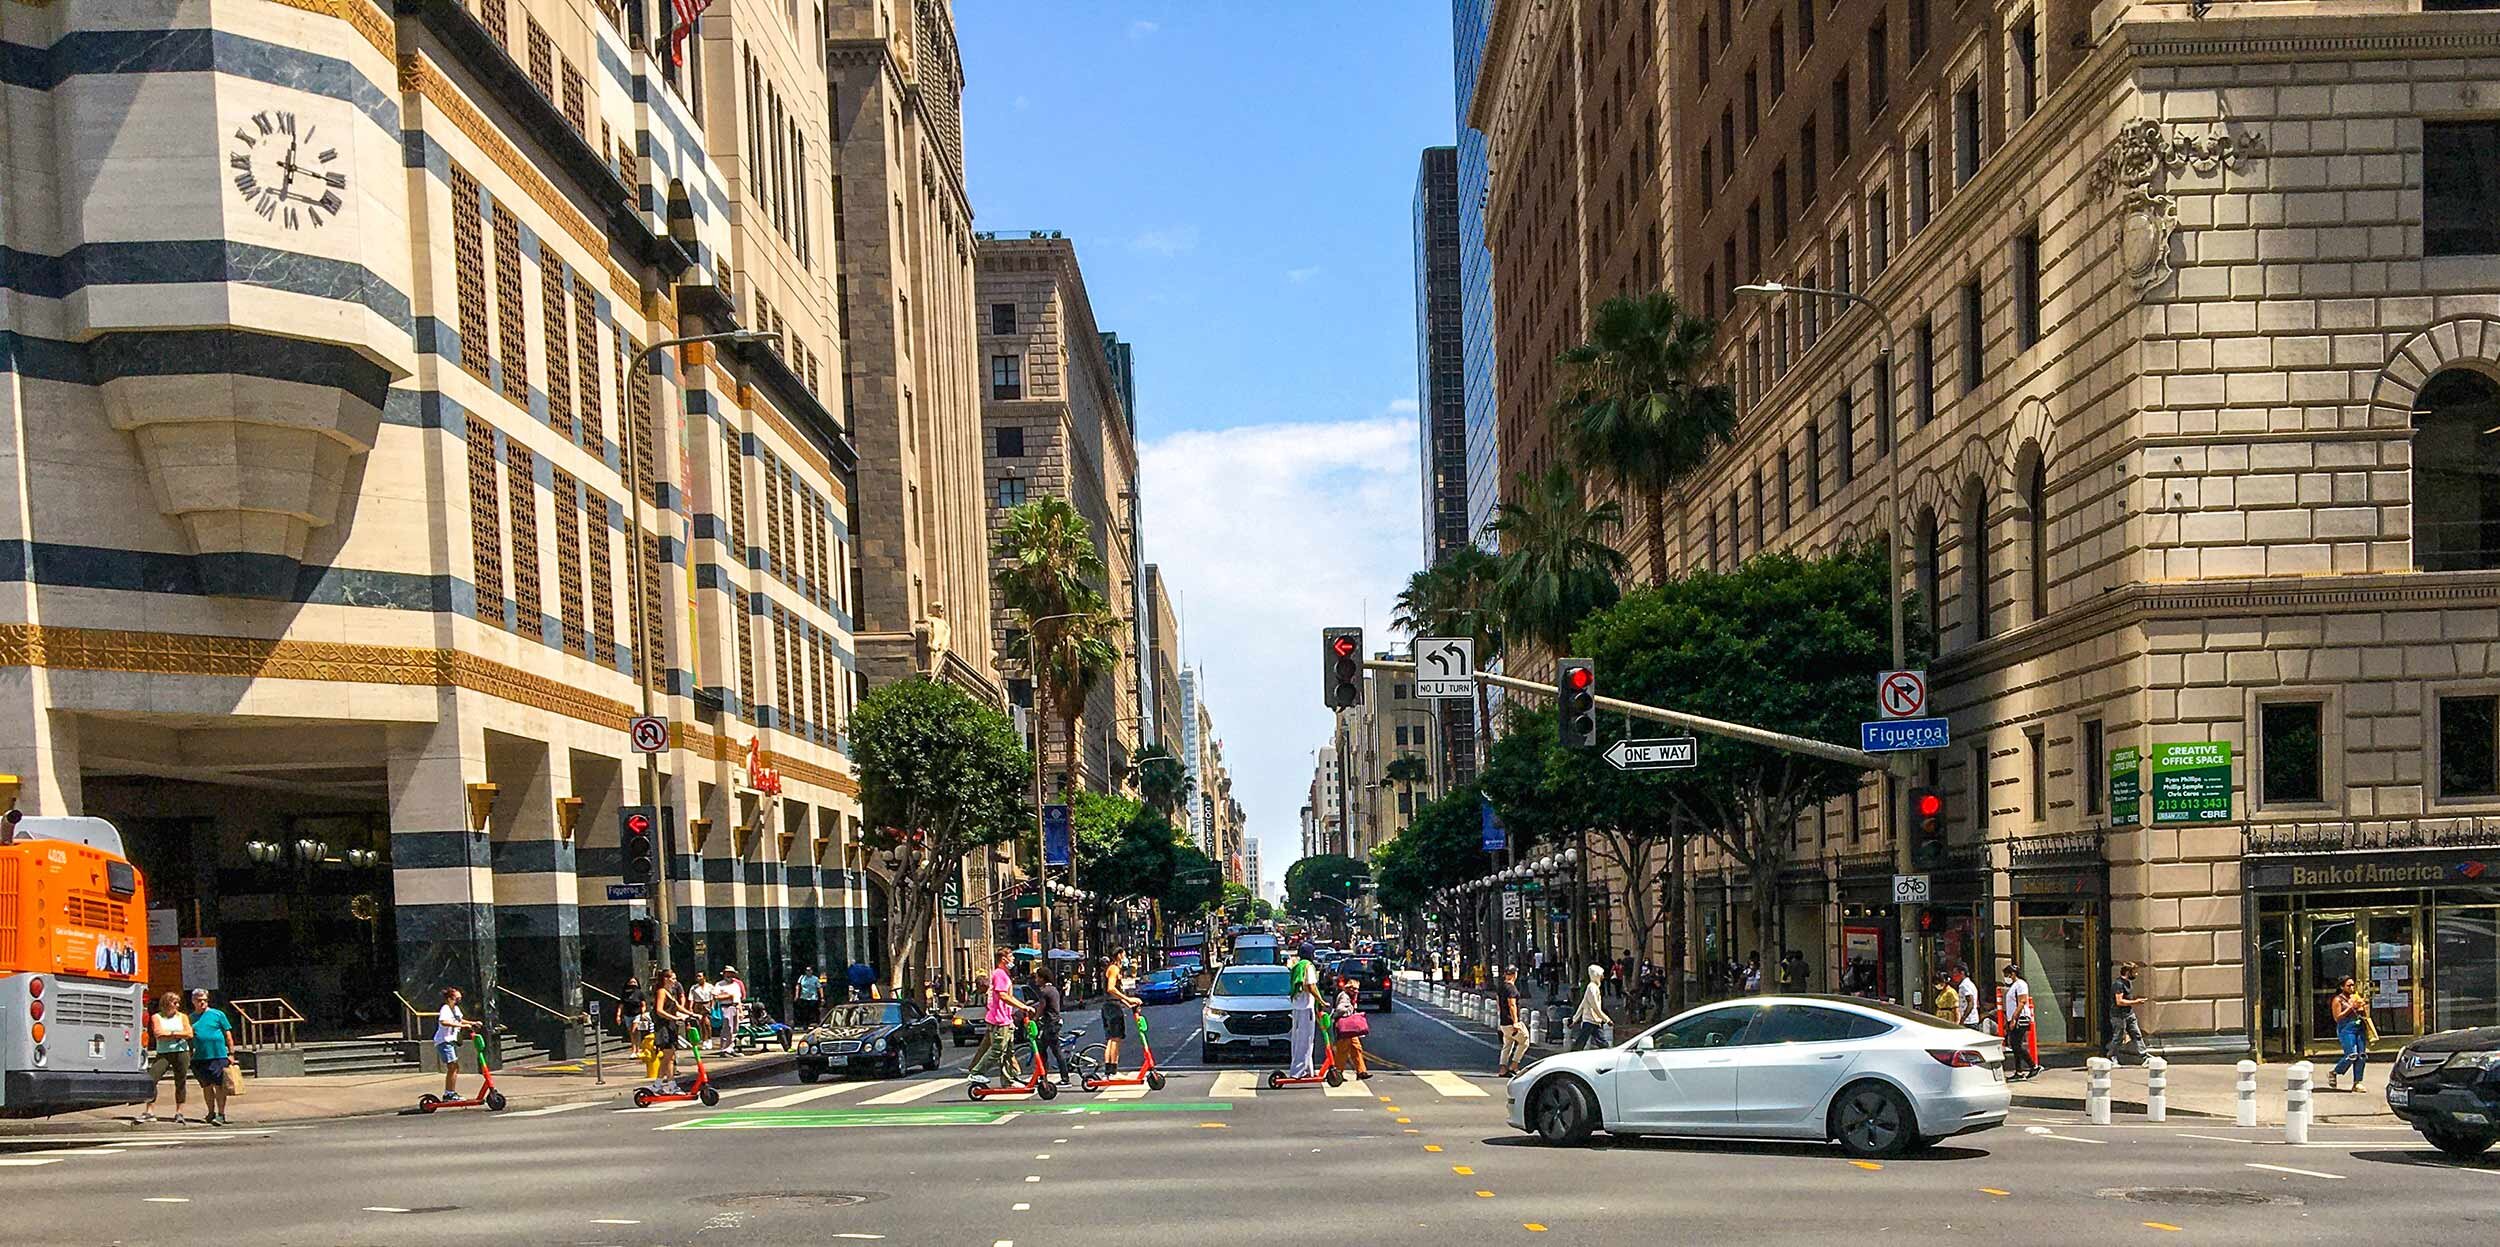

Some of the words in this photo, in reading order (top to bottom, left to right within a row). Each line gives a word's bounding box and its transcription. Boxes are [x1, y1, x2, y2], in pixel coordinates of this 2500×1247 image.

[1420, 684, 1432, 693] NO
[1435, 683, 1445, 694] U
[1449, 684, 1470, 693] TURN
[1869, 727, 1942, 746] Figueroa
[1624, 747, 1651, 761] ONE
[1659, 746, 1687, 760] WAY
[2168, 745, 2218, 755] CREATIVE
[2161, 757, 2194, 766] OFFICE
[2195, 755, 2225, 764] SPACE
[2158, 800, 2178, 810] 213
[2180, 799, 2200, 809] 613
[2203, 798, 2228, 808] 3431
[2200, 809, 2228, 819] CBRE
[2292, 865, 2342, 885] Bank
[2344, 864, 2364, 883] of
[2365, 862, 2443, 883] America
